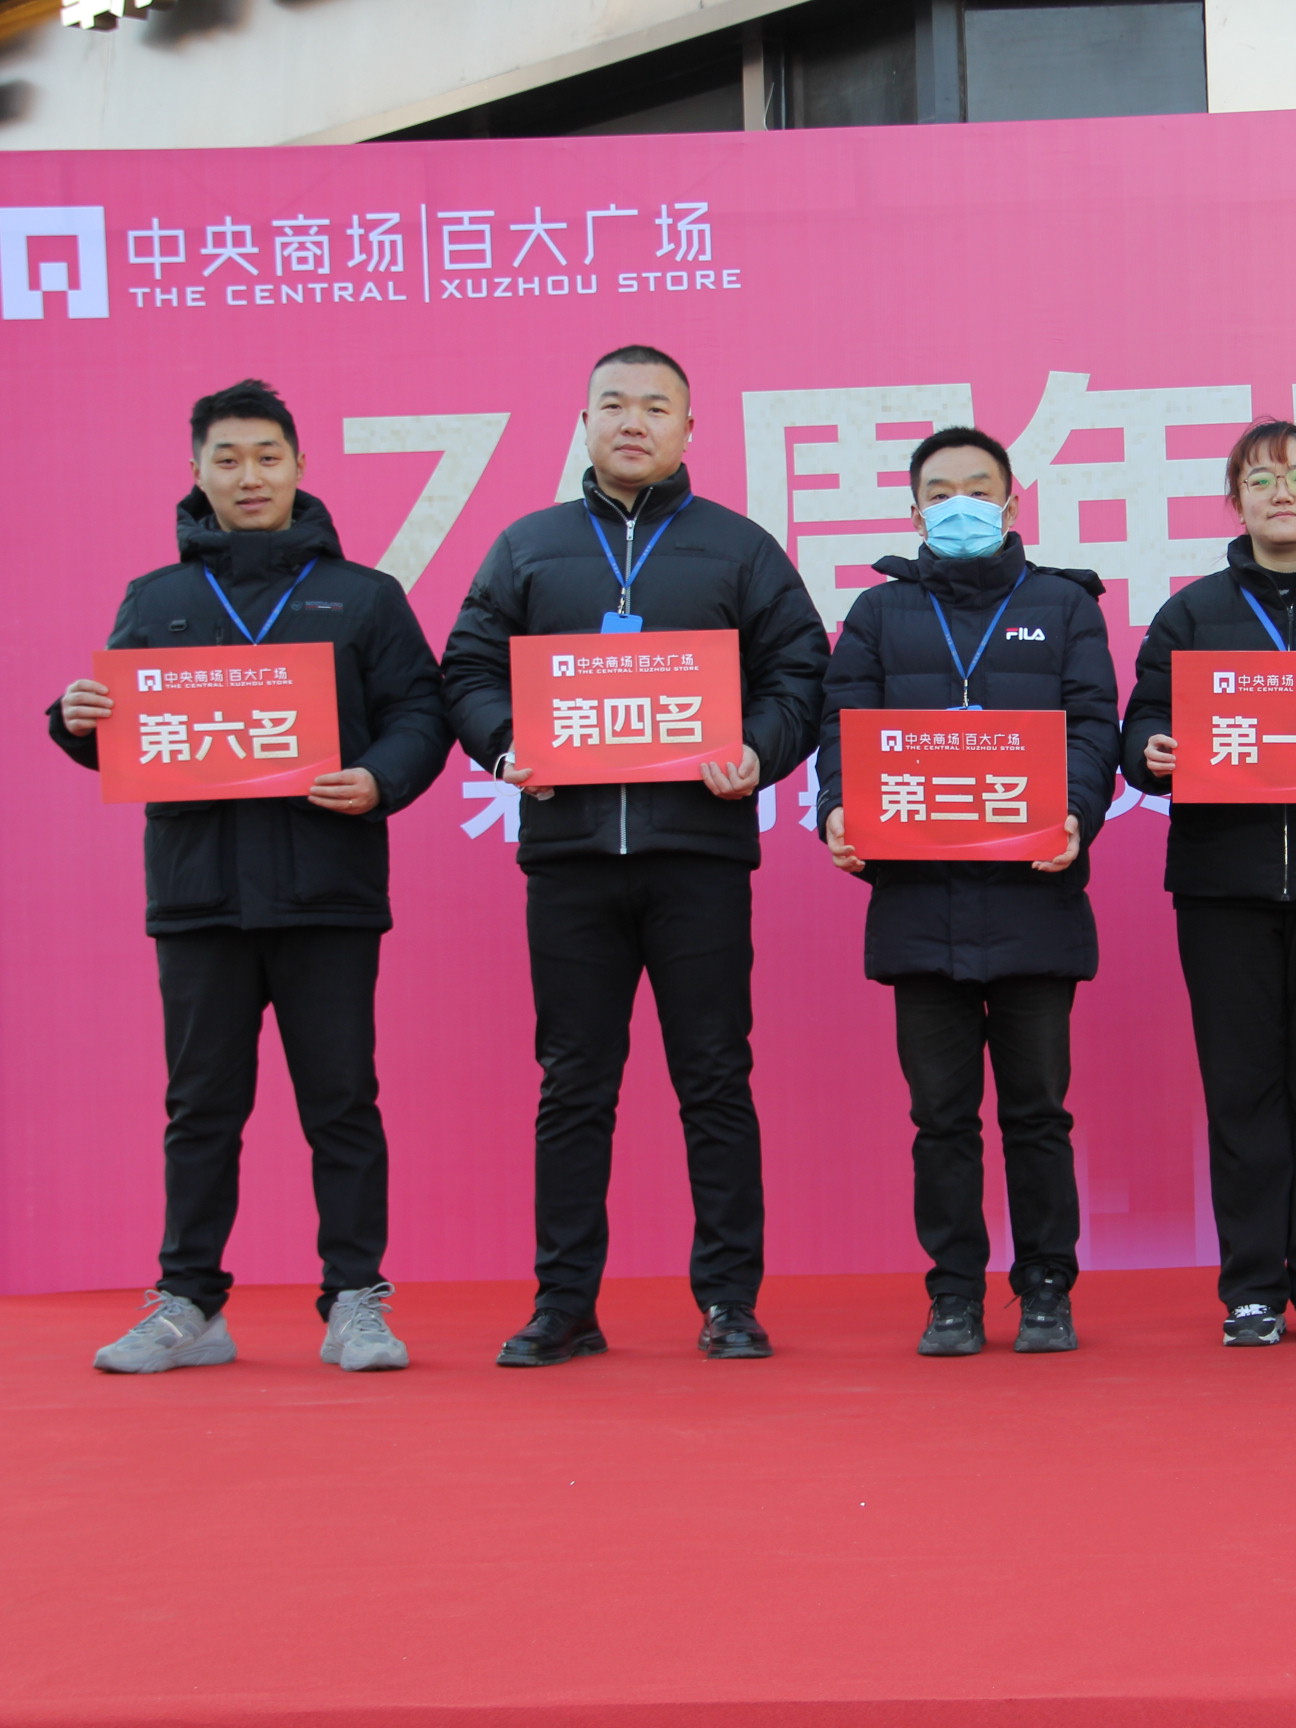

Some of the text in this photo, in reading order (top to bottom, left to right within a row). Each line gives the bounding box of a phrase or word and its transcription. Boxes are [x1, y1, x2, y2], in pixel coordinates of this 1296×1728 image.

[127, 202, 712, 280] 中央商场 百大广场
[129, 269, 741, 308] THE CENTRAL XUZHOU STORE
[1005, 627, 1046, 641] FILA
[577, 653, 694, 669] 中央商场 百大广场
[164, 667, 288, 683] 中央商场 百大广场
[1238, 674, 1294, 687] 中央商场
[552, 695, 703, 748] 第四名
[139, 710, 299, 765] 第六名
[905, 732, 1020, 746] 中央商场 百大广场
[880, 773, 1028, 823] 第三名
